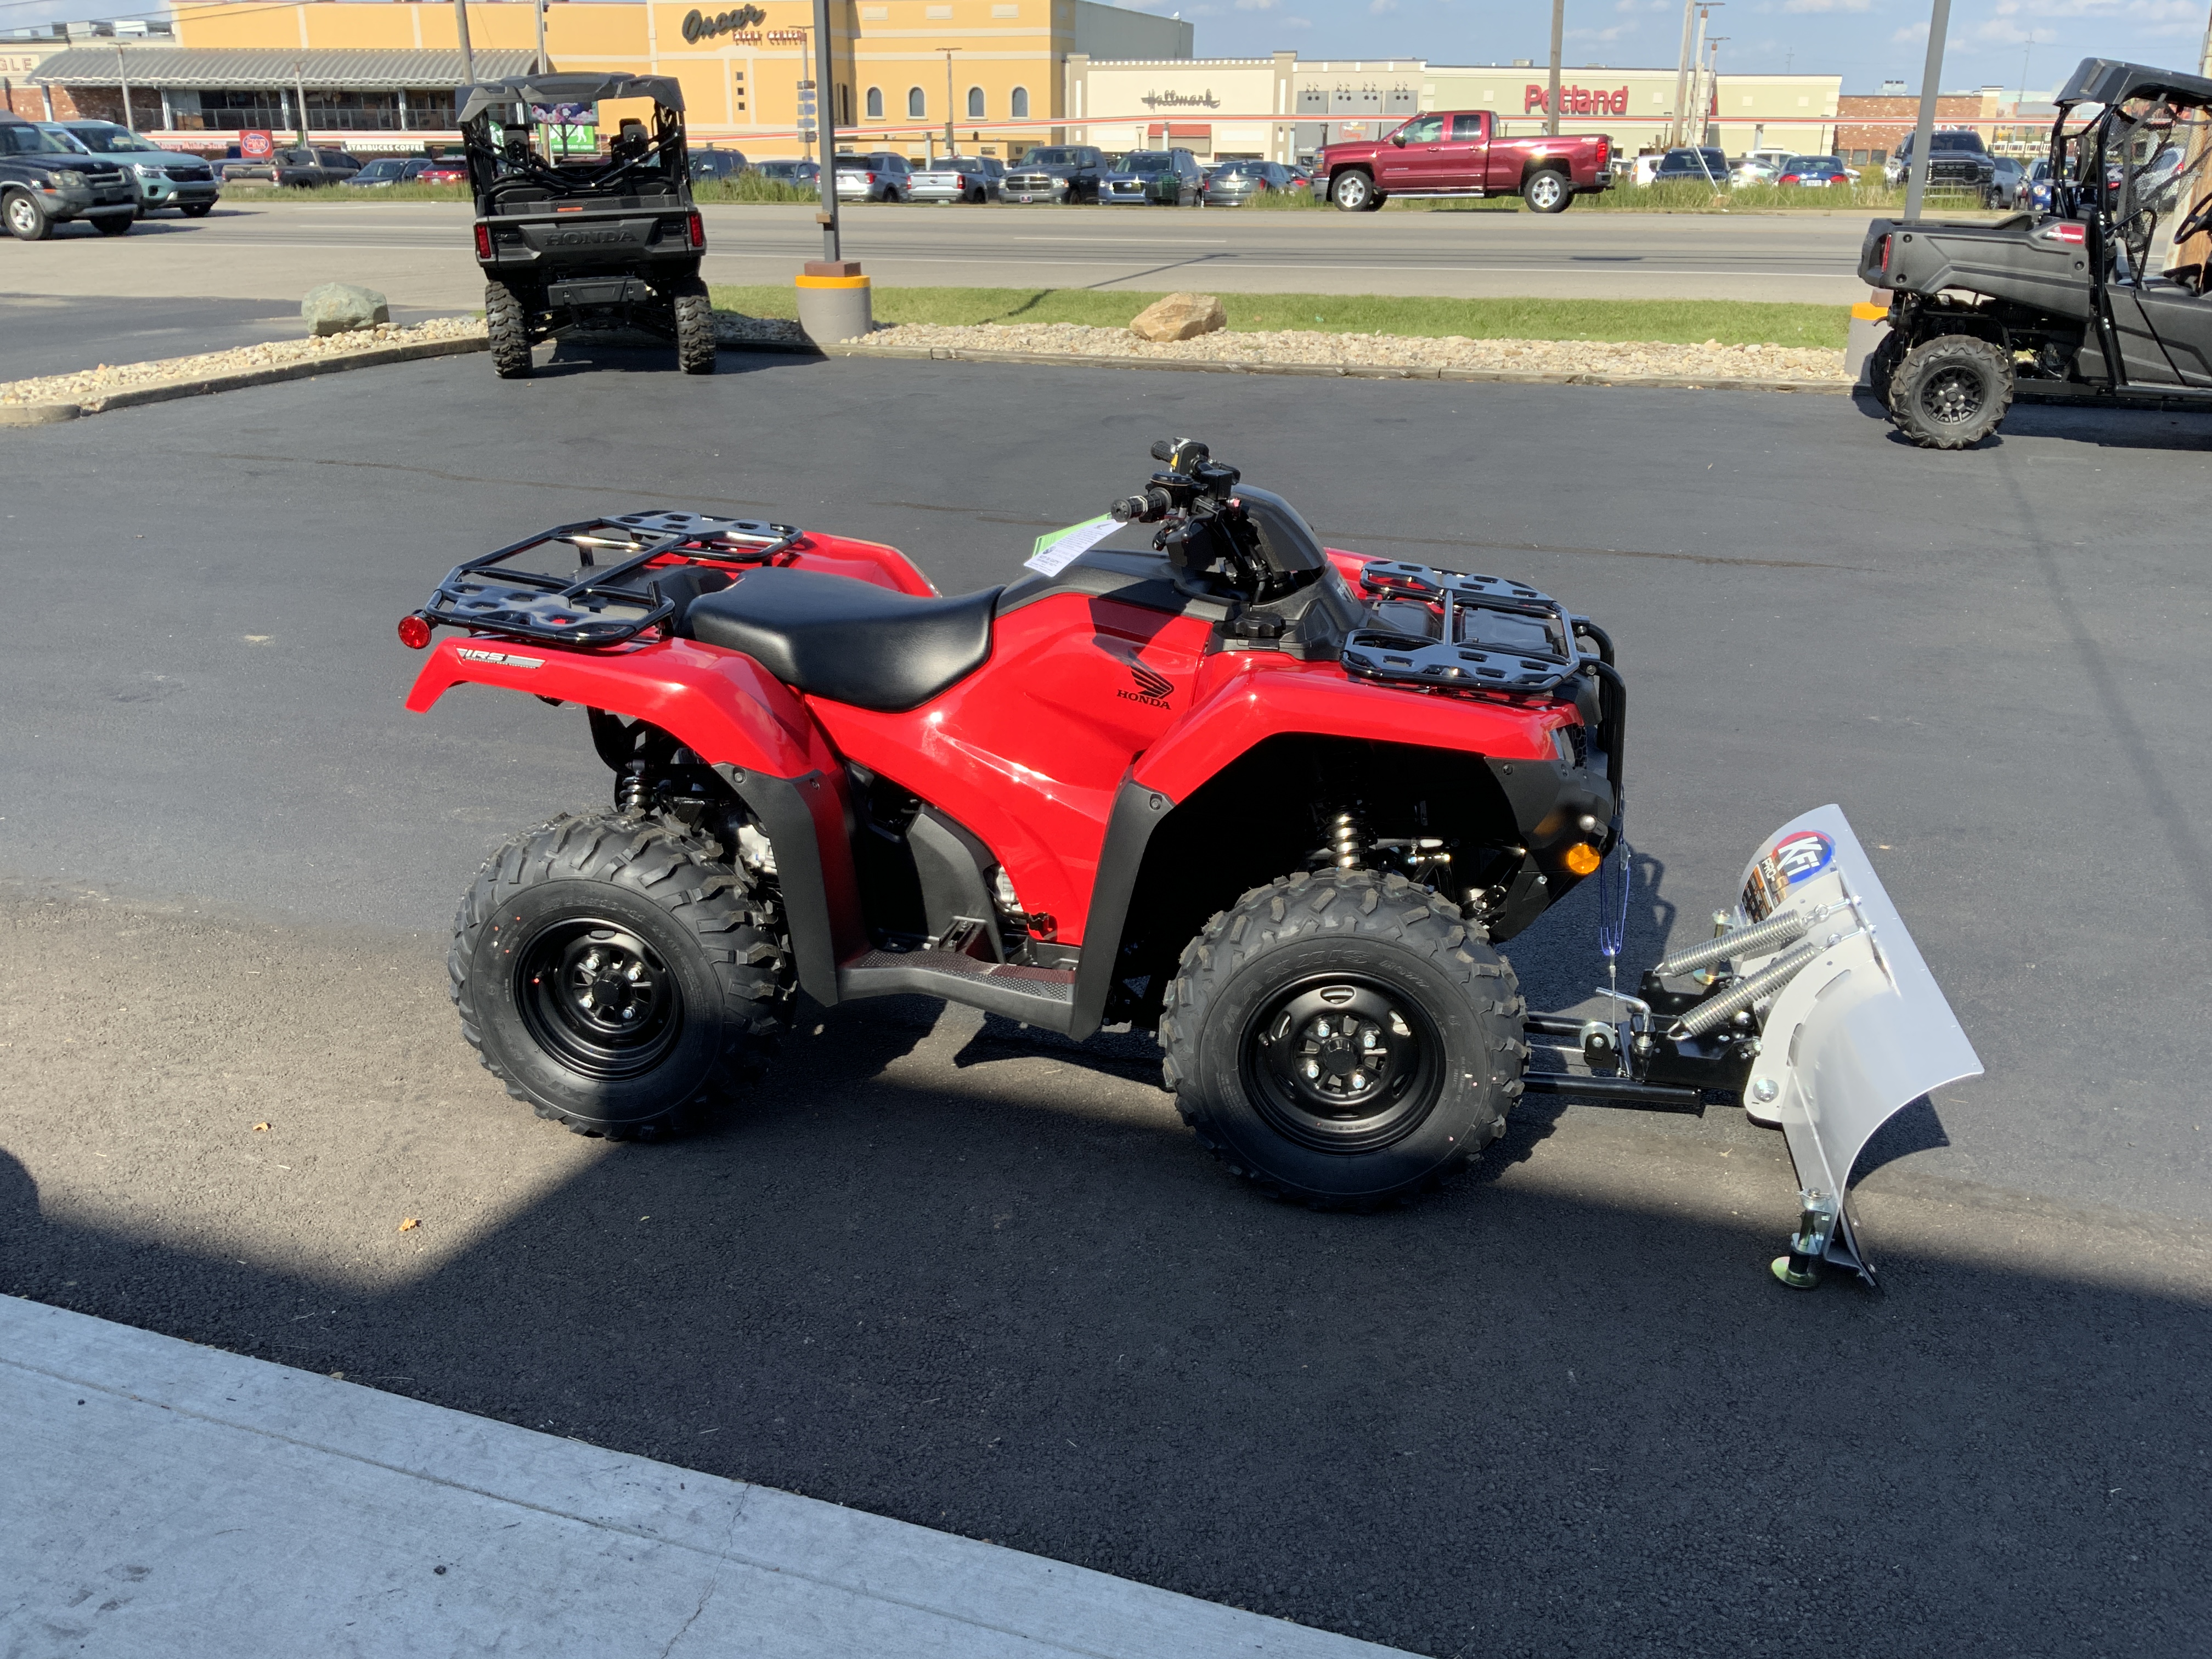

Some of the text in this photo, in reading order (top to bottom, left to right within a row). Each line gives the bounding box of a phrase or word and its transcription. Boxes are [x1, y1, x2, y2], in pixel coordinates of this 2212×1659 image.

[682, 3, 766, 44] Oscar
[732, 30, 763, 46] EVENT
[1141, 88, 1221, 114] Hallmark
[1525, 84, 1629, 115] Petland
[543, 230, 640, 246] HONDA
[466, 650, 505, 661] IRS
[1116, 689, 1172, 710] HONDA
[1221, 949, 1370, 1035] MAXXIS
